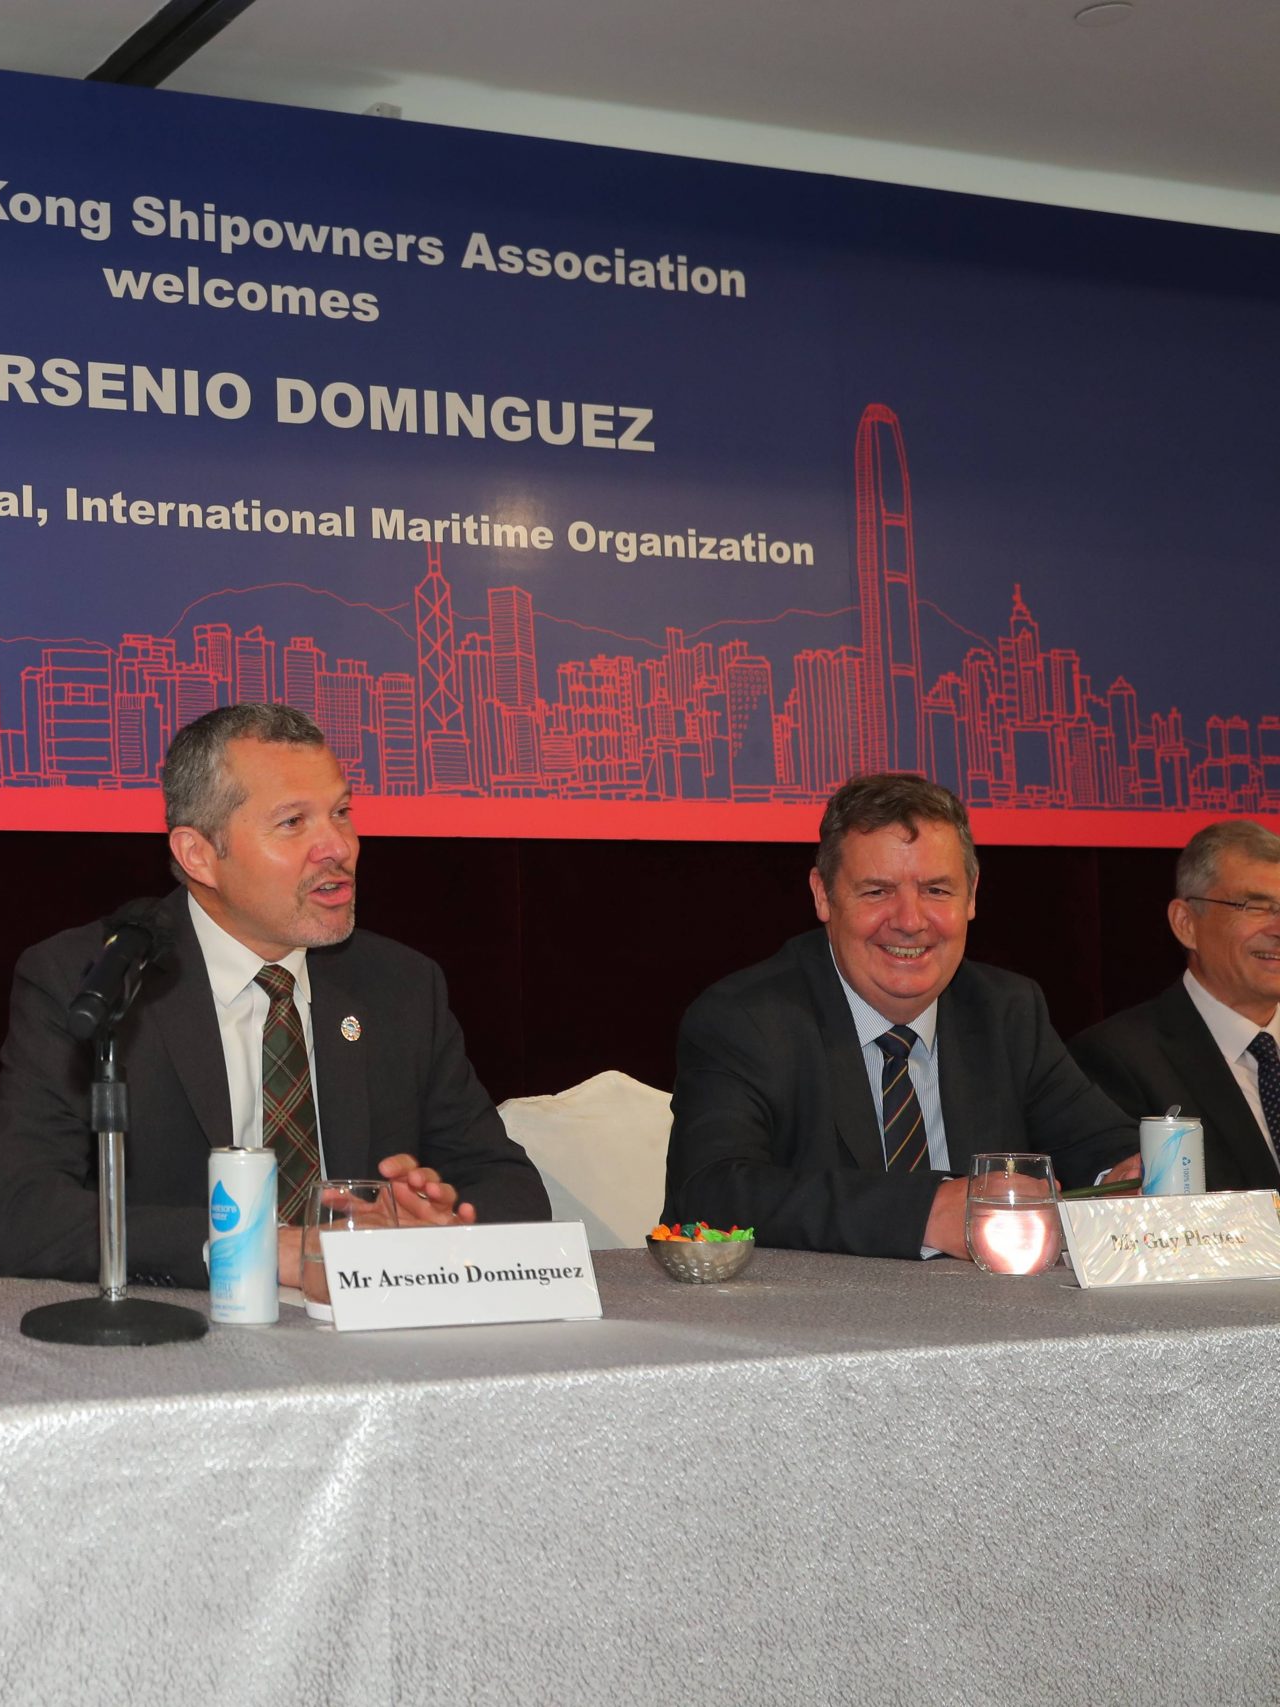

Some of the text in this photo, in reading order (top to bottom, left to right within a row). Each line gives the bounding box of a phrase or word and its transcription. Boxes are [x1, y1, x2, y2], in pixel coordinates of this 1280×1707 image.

[131, 196, 446, 267] Shipowners
[461, 232, 746, 298] Association
[102, 266, 381, 323] welcomes
[276, 377, 656, 452] DOMINGUEZ
[66, 487, 355, 538] International
[371, 507, 555, 552] Maritime
[567, 520, 815, 566] Organization
[1143, 1232, 1180, 1253] Guy
[338, 1262, 584, 1290] Mr Arsenio Dominguez
